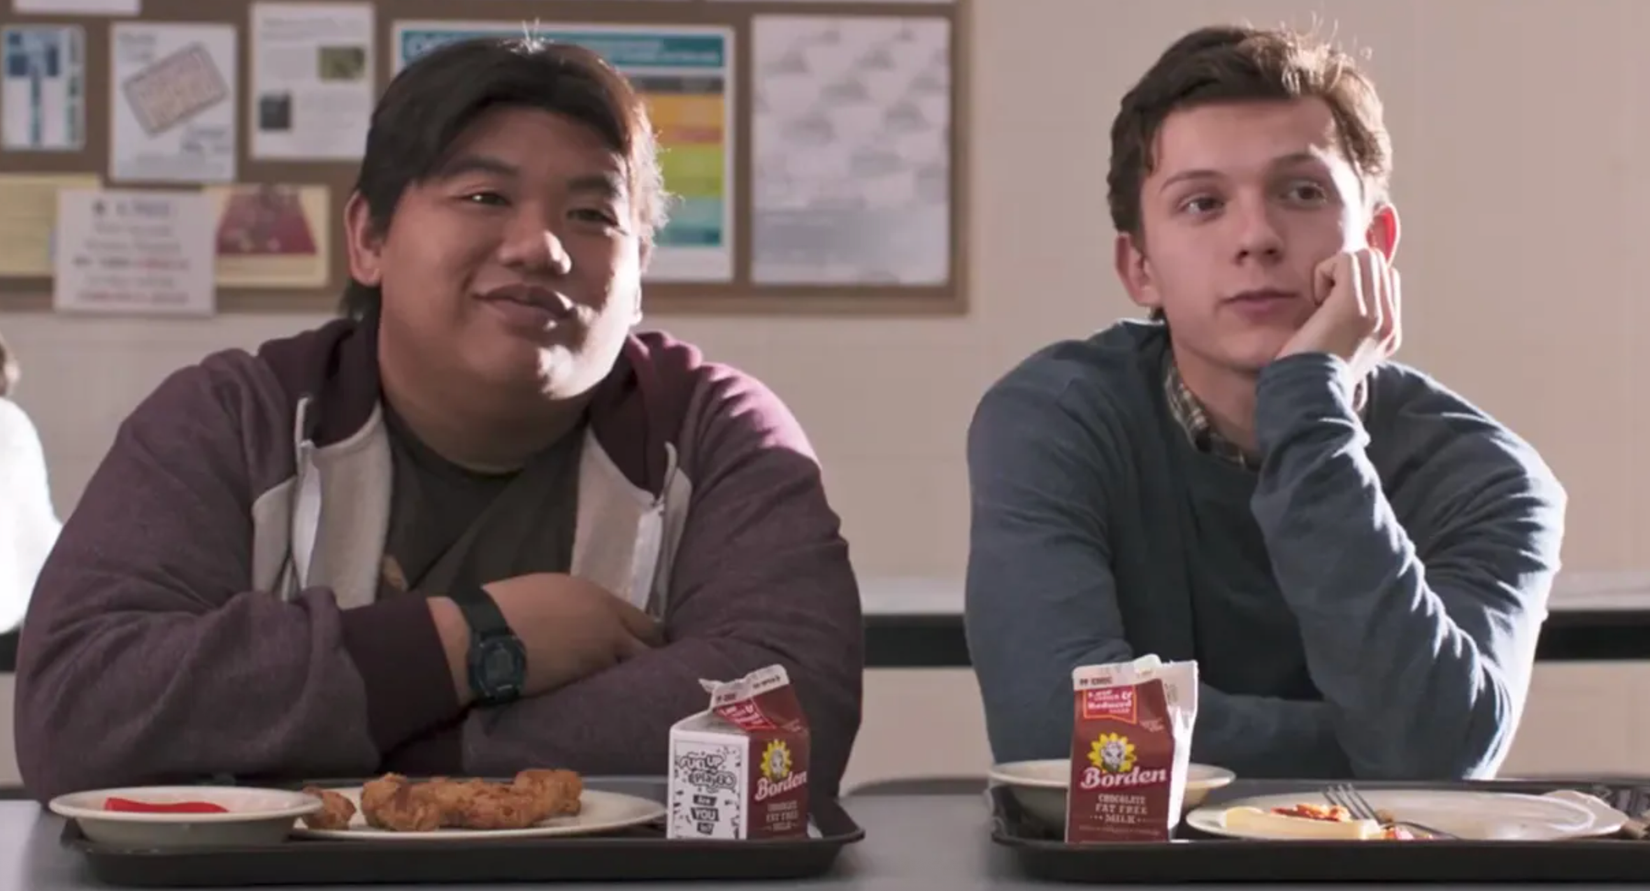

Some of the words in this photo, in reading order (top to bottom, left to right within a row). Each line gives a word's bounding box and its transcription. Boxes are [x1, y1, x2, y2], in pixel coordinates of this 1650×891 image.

[1080, 766, 1167, 790] Borden
[755, 770, 807, 802] Borden
[1098, 793, 1146, 805] CHOCOLATE
[695, 808, 717, 820] YOU
[1095, 803, 1116, 813] FAT
[1119, 805, 1148, 815] FREE
[1105, 814, 1136, 824] MILK
